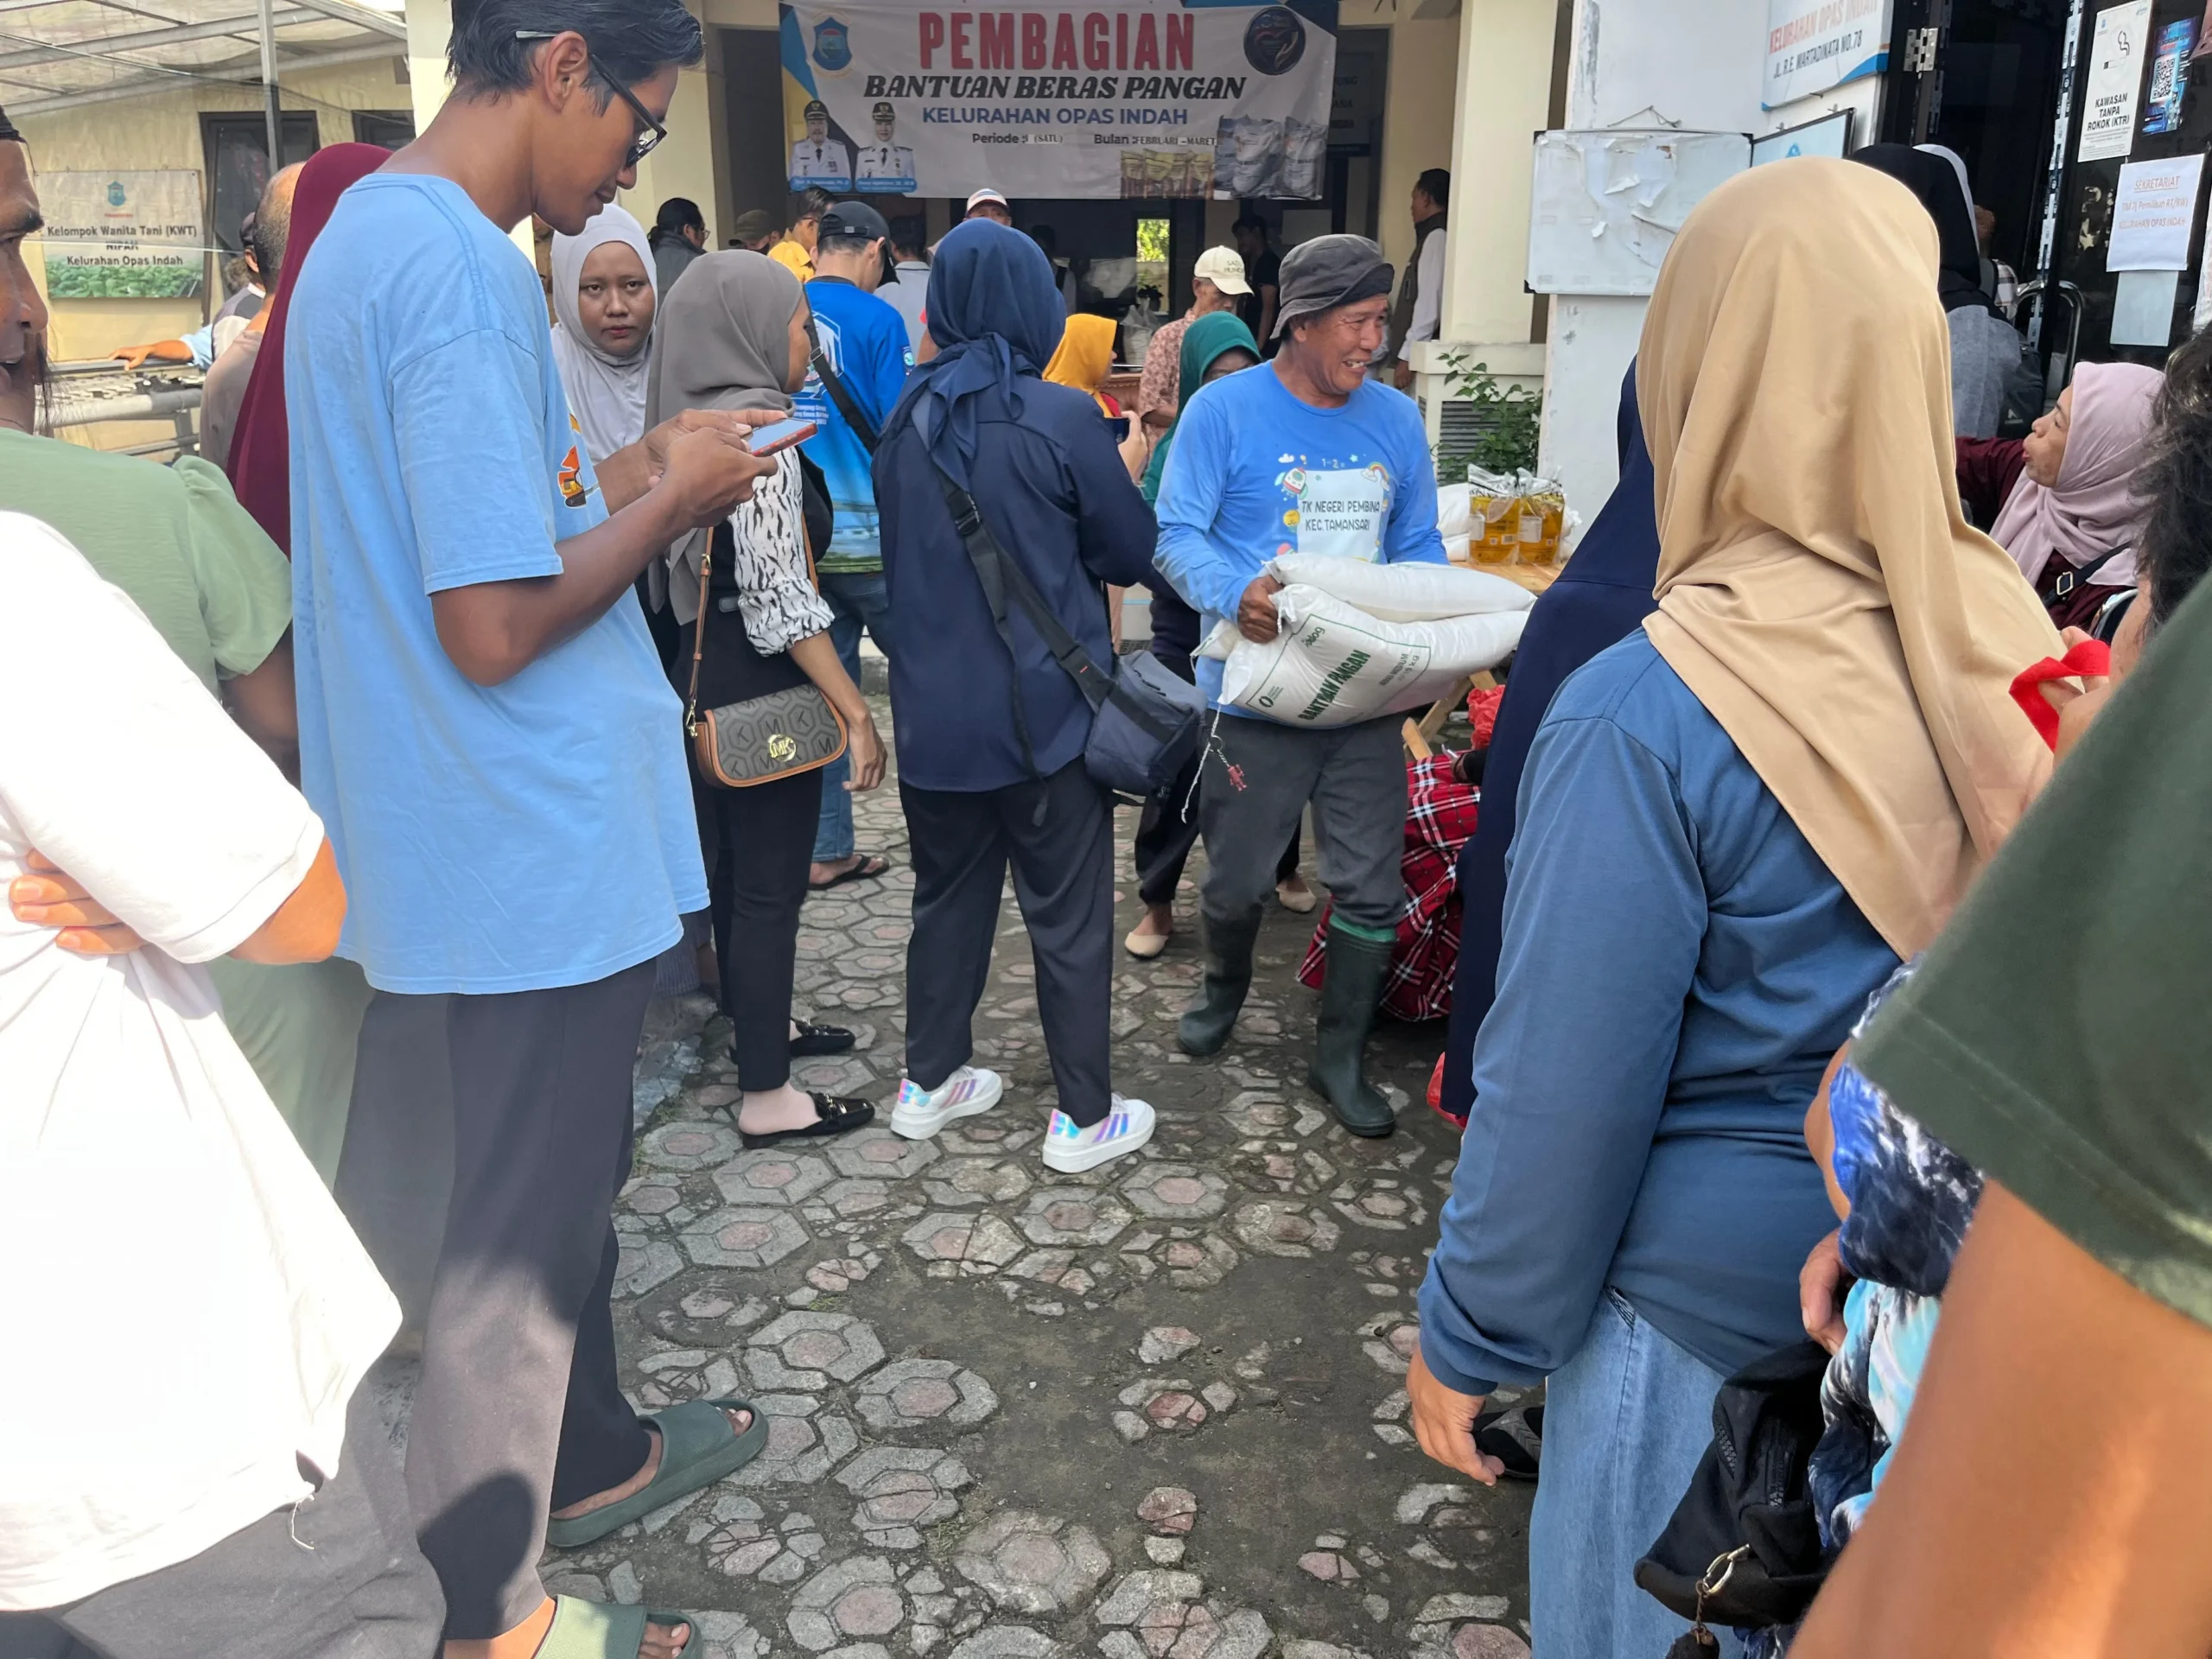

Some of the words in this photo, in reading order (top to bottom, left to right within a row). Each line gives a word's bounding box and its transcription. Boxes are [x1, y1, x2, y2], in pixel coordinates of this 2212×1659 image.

[919, 12, 1194, 71] PEMBAGIAN
[863, 75, 1012, 99] BANTUAN
[1014, 76, 1119, 99] BERAS
[1122, 76, 1248, 99] PANGAN
[2094, 93, 2128, 108] KAWASAN
[923, 107, 1051, 124] KELURAHAN
[1057, 108, 1114, 124] OPAS
[1121, 109, 1187, 124] INDAH
[2099, 106, 2120, 119] TANPA
[2087, 118, 2110, 131] ROKOK
[2111, 115, 2130, 129] (KTR)
[972, 132, 1020, 144] Periode
[1094, 133, 1129, 144] Bulan
[2134, 175, 2180, 192] SEKRETARIAT
[48, 226, 98, 238] Kelompok
[100, 226, 137, 236] Wanita
[139, 226, 162, 236] Tani
[166, 226, 197, 238] (KWT)
[67, 256, 119, 266] Kelurahan
[123, 256, 149, 266] Opas
[153, 256, 183, 266] Indah
[1302, 501, 1313, 512] TK
[1314, 501, 1344, 513] NEGERI
[1347, 500, 1381, 512] PEMBINA
[1327, 649, 1371, 688] PANGAN
